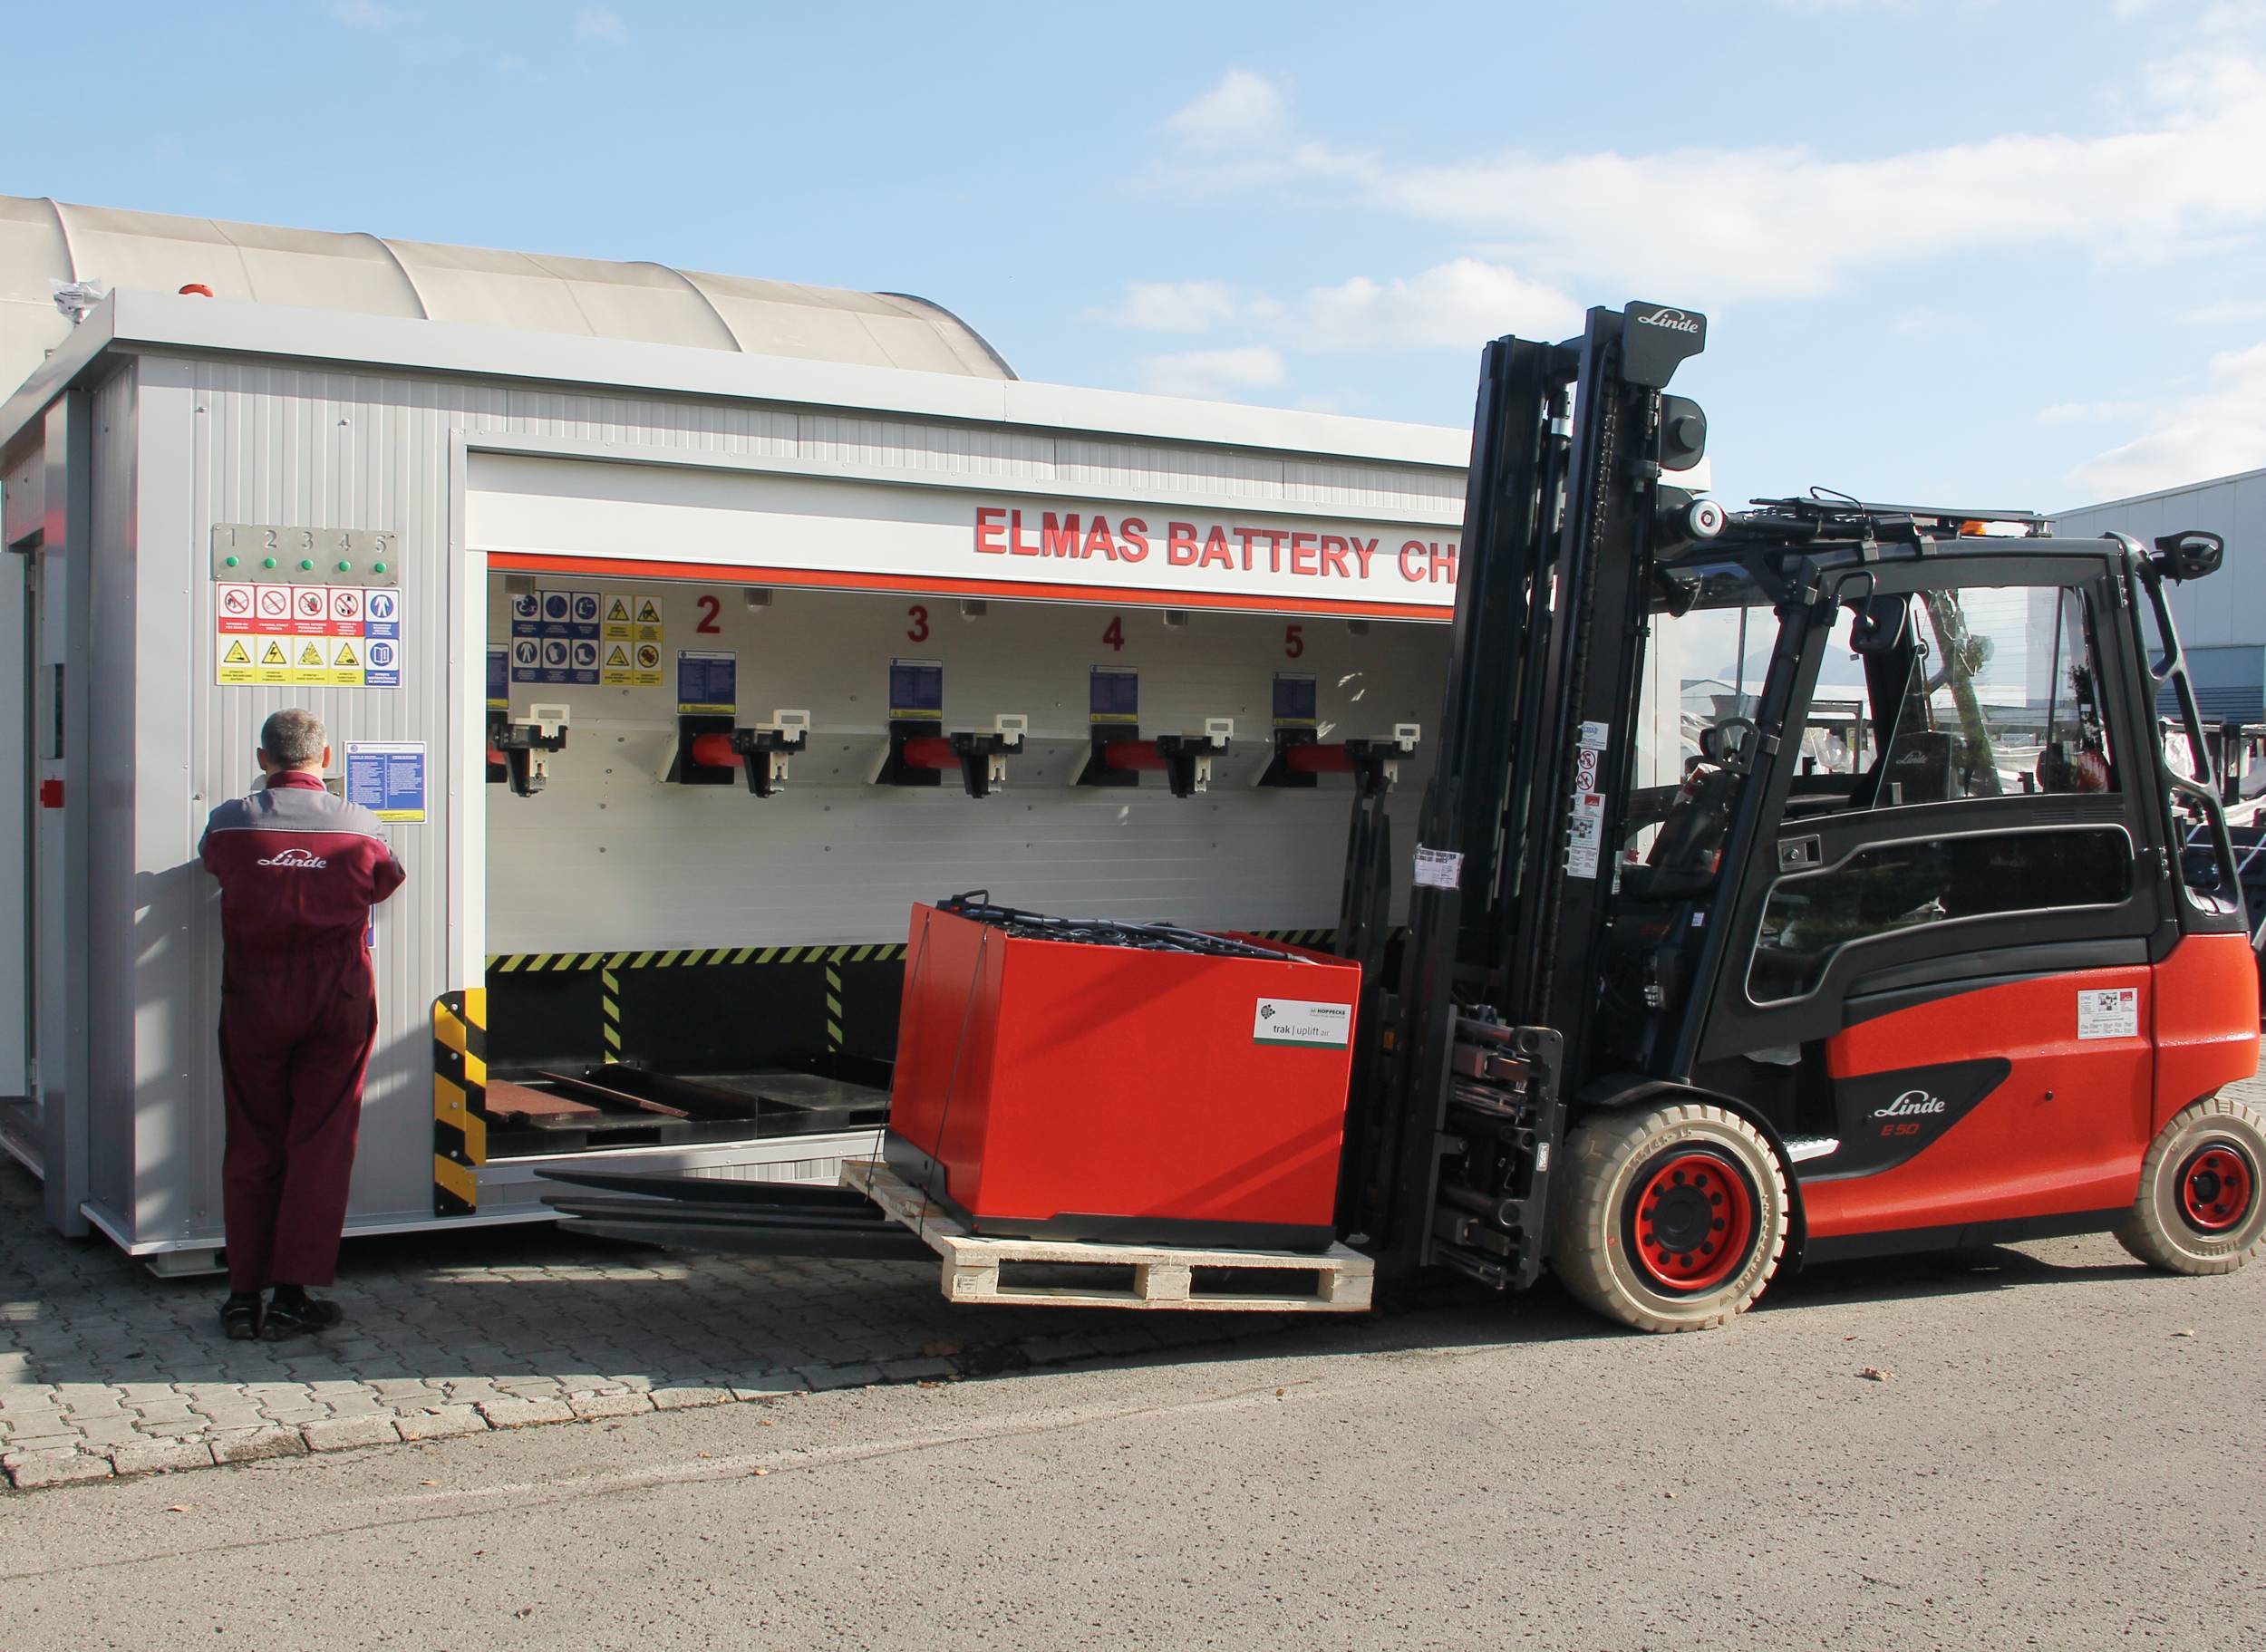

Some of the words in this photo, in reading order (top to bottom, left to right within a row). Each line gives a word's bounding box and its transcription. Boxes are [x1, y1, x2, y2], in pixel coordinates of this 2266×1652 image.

[1638, 308, 1699, 333] Linde
[226, 527, 236, 546] 1
[265, 529, 277, 548] 2
[302, 531, 314, 550] 3
[339, 533, 352, 551] 4
[374, 535, 387, 554] 5
[974, 507, 1149, 562] ELMAS
[1167, 520, 1380, 579] BATTERY
[696, 594, 721, 634] 2
[907, 604, 929, 642] 3
[1102, 615, 1125, 652] 4
[1284, 624, 1303, 659] 5
[257, 848, 327, 869] Linde
[1273, 1025, 1291, 1034] trak
[1296, 1026, 1319, 1037] uplift
[1874, 1090, 1945, 1116] Linde
[1881, 1124, 1893, 1135] E
[1894, 1123, 1921, 1135] 50
